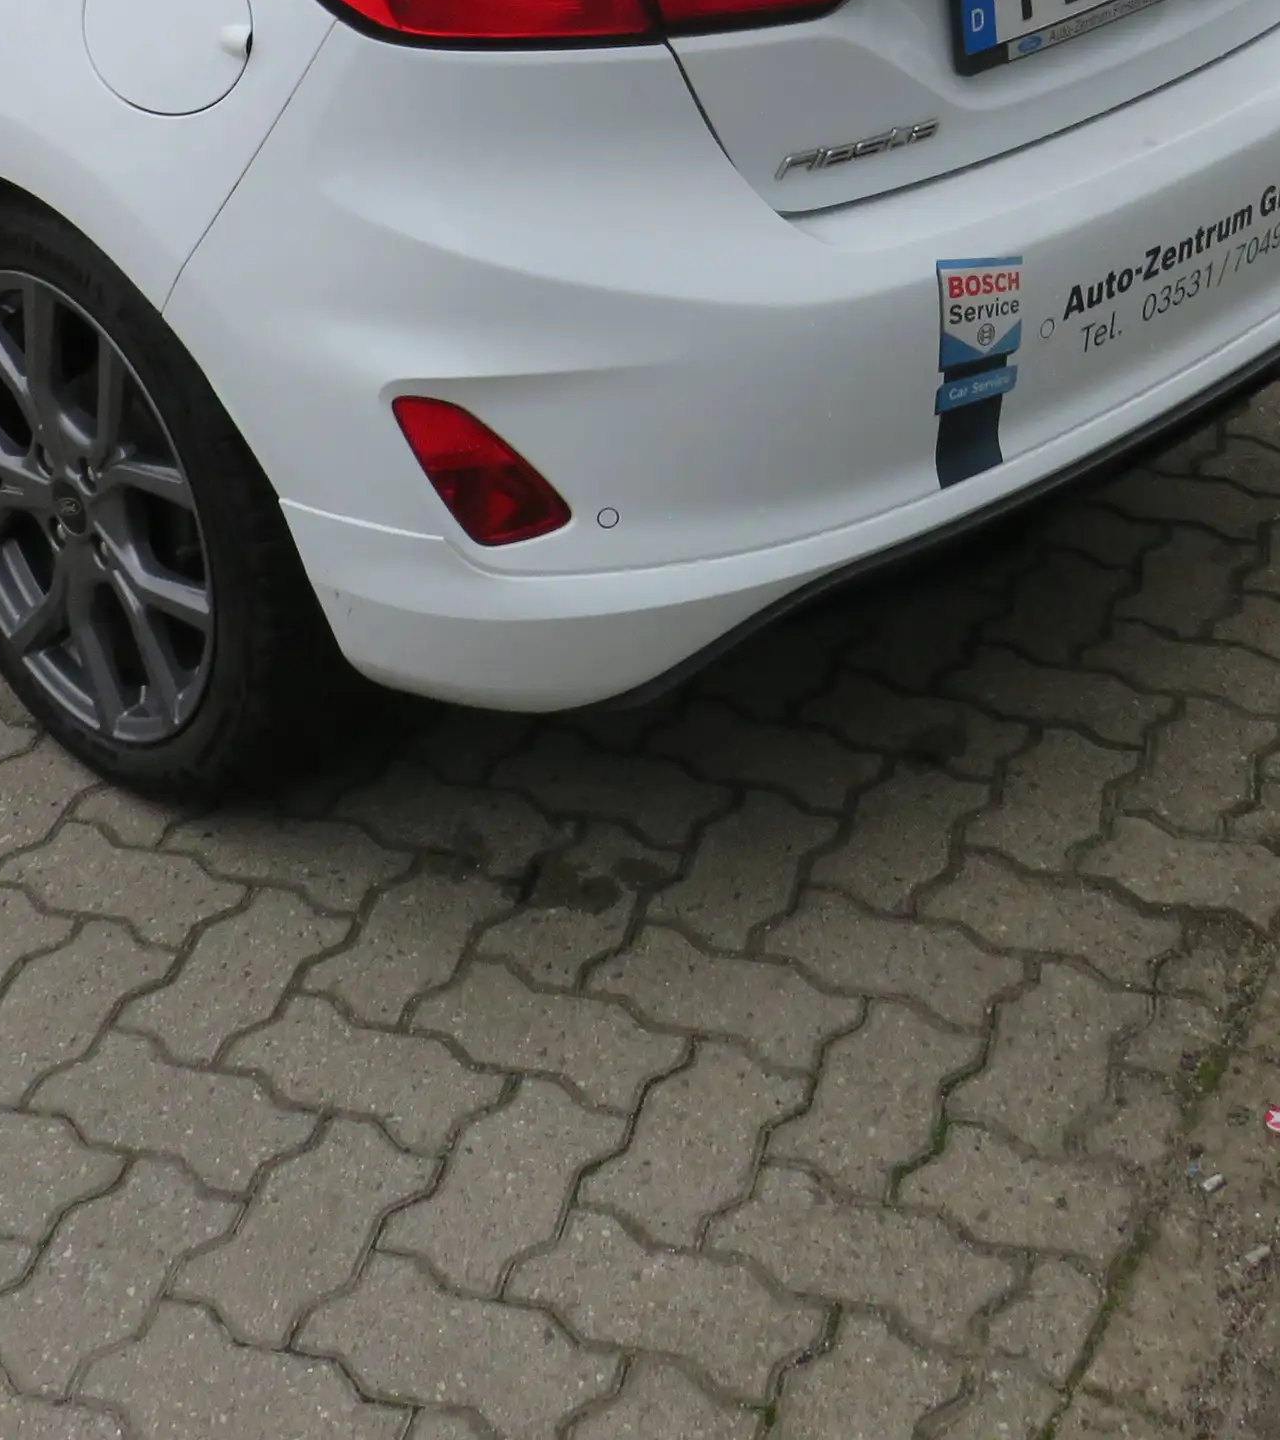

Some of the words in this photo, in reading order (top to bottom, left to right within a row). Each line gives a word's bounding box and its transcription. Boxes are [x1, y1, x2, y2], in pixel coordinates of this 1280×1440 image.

[971, 8, 985, 33] D
[774, 117, 940, 181] Fiesta
[1062, 203, 1253, 321] Auto-Zentrum
[947, 271, 1020, 299] BOSCH
[948, 297, 1021, 325] Service
[1080, 313, 1123, 354] Tel.
[948, 385, 969, 401] Car
[971, 373, 1010, 394] Service
